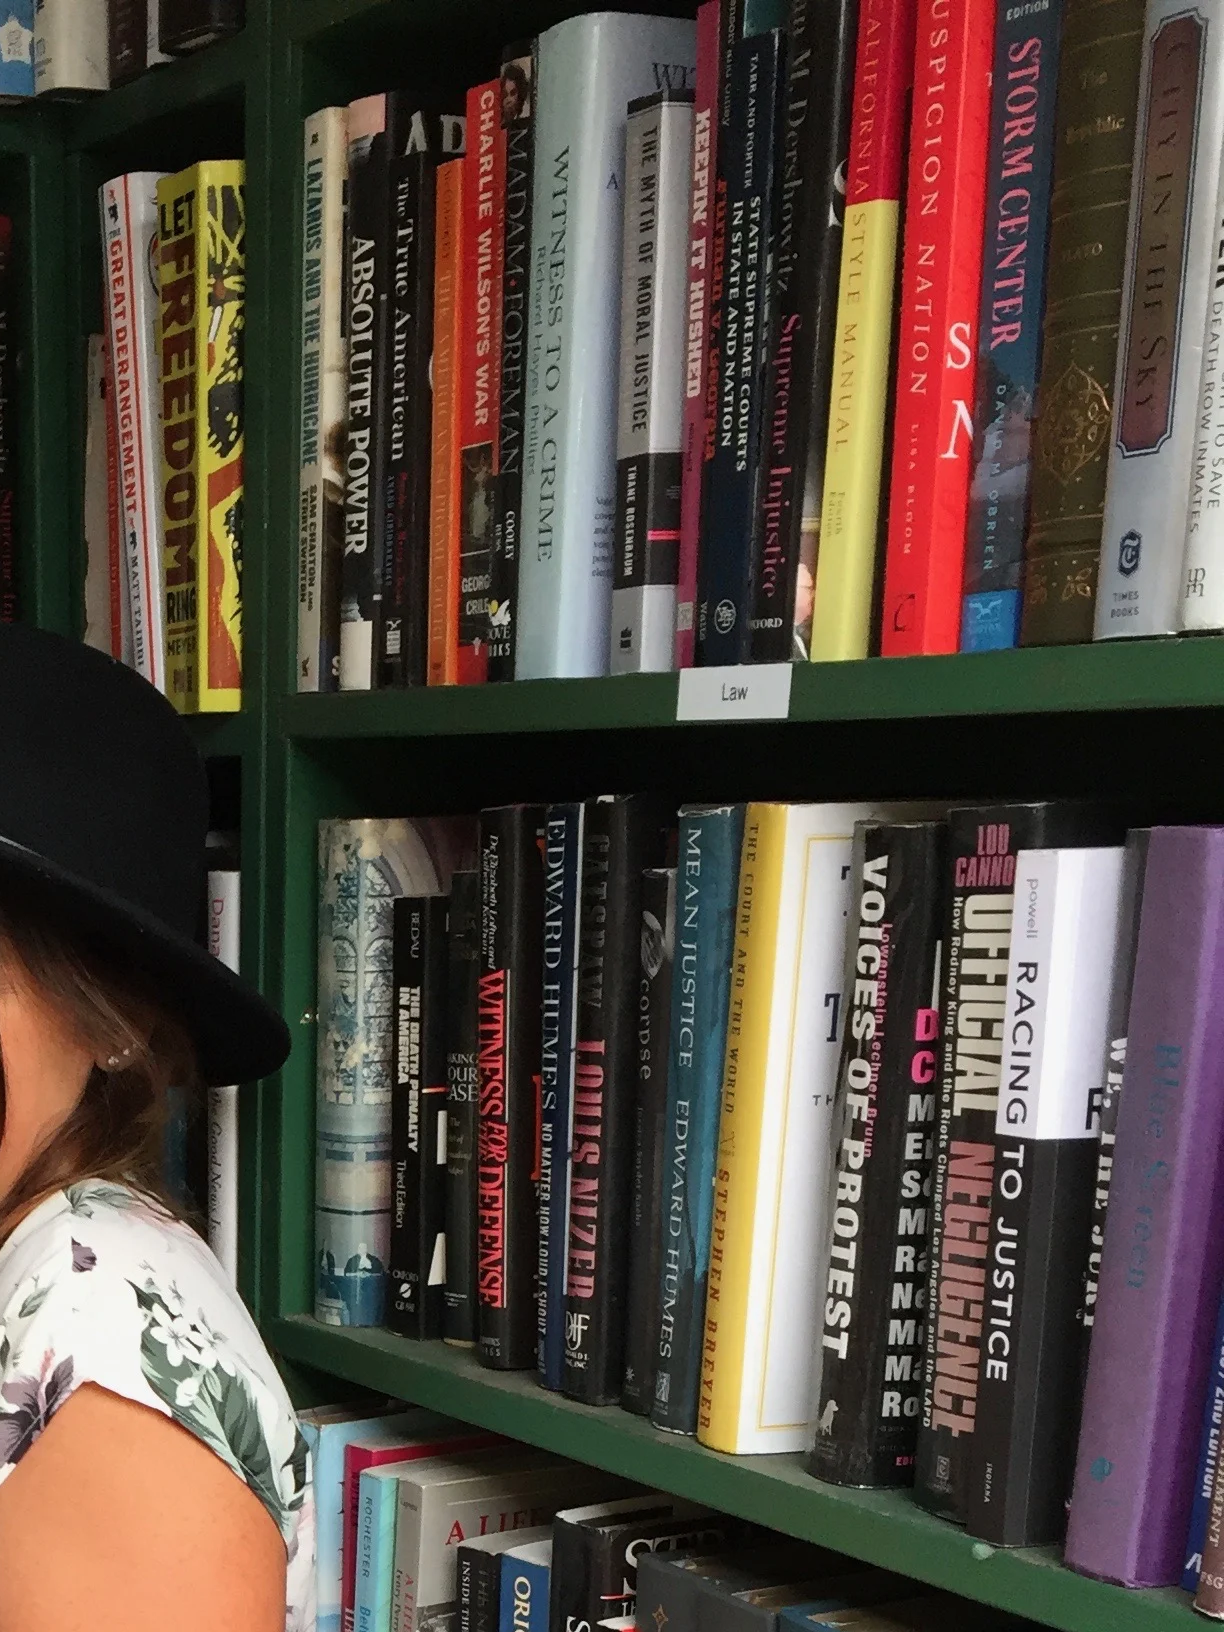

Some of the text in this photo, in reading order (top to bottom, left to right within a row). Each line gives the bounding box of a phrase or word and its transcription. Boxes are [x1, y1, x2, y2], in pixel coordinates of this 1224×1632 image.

[473, 89, 495, 425] CHARLIE WILSON'S WAR
[991, 38, 1040, 349] STORM CENTER
[345, 236, 375, 554] ABSOLUTE POWER
[538, 146, 572, 563] WITNESS TO A CRIME
[722, 683, 748, 701] Law
[542, 816, 566, 1111] EDWARD HUMES
[1026, 878, 1039, 939] powell
[822, 856, 888, 1359] VOICES OF PROTEST
[986, 961, 1038, 1383] RACING TO JUSTICE
